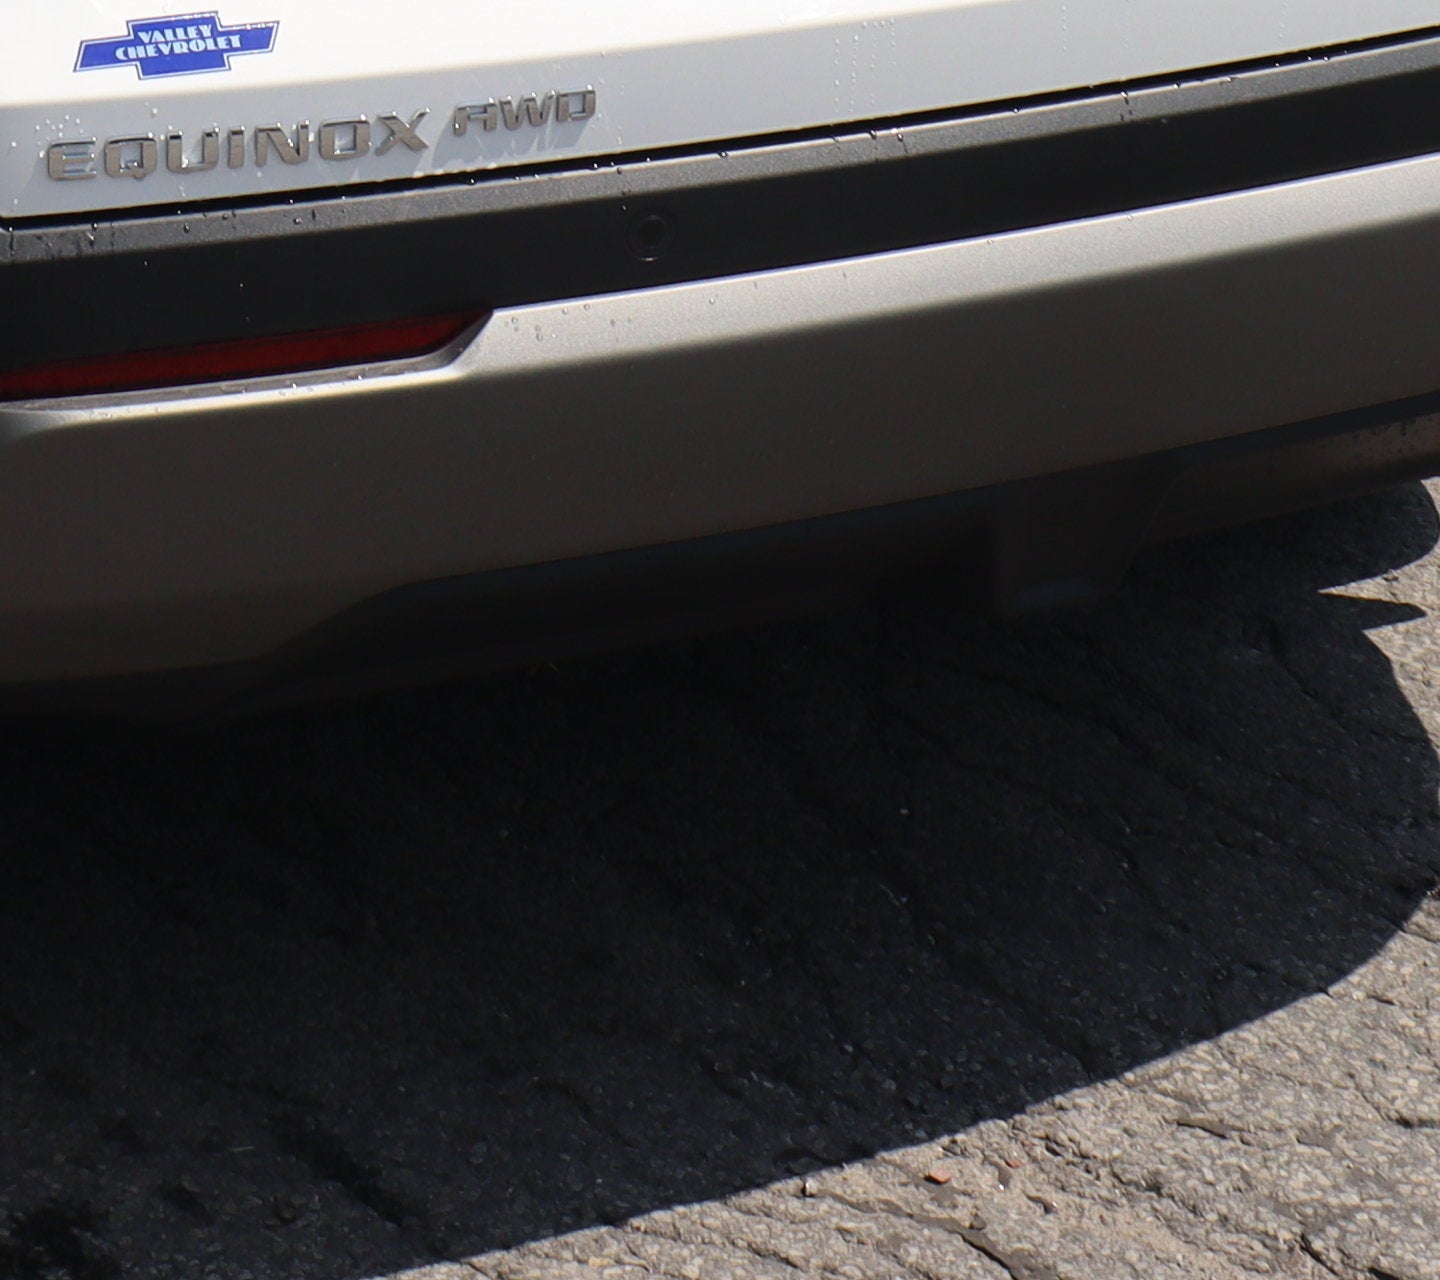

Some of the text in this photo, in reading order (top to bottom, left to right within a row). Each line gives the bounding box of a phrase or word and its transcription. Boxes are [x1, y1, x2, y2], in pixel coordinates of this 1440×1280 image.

[114, 33, 242, 62] CHEVROLET
[136, 23, 214, 46] VALLEY
[452, 83, 597, 138] AWD
[46, 108, 432, 182] EQUINOX
